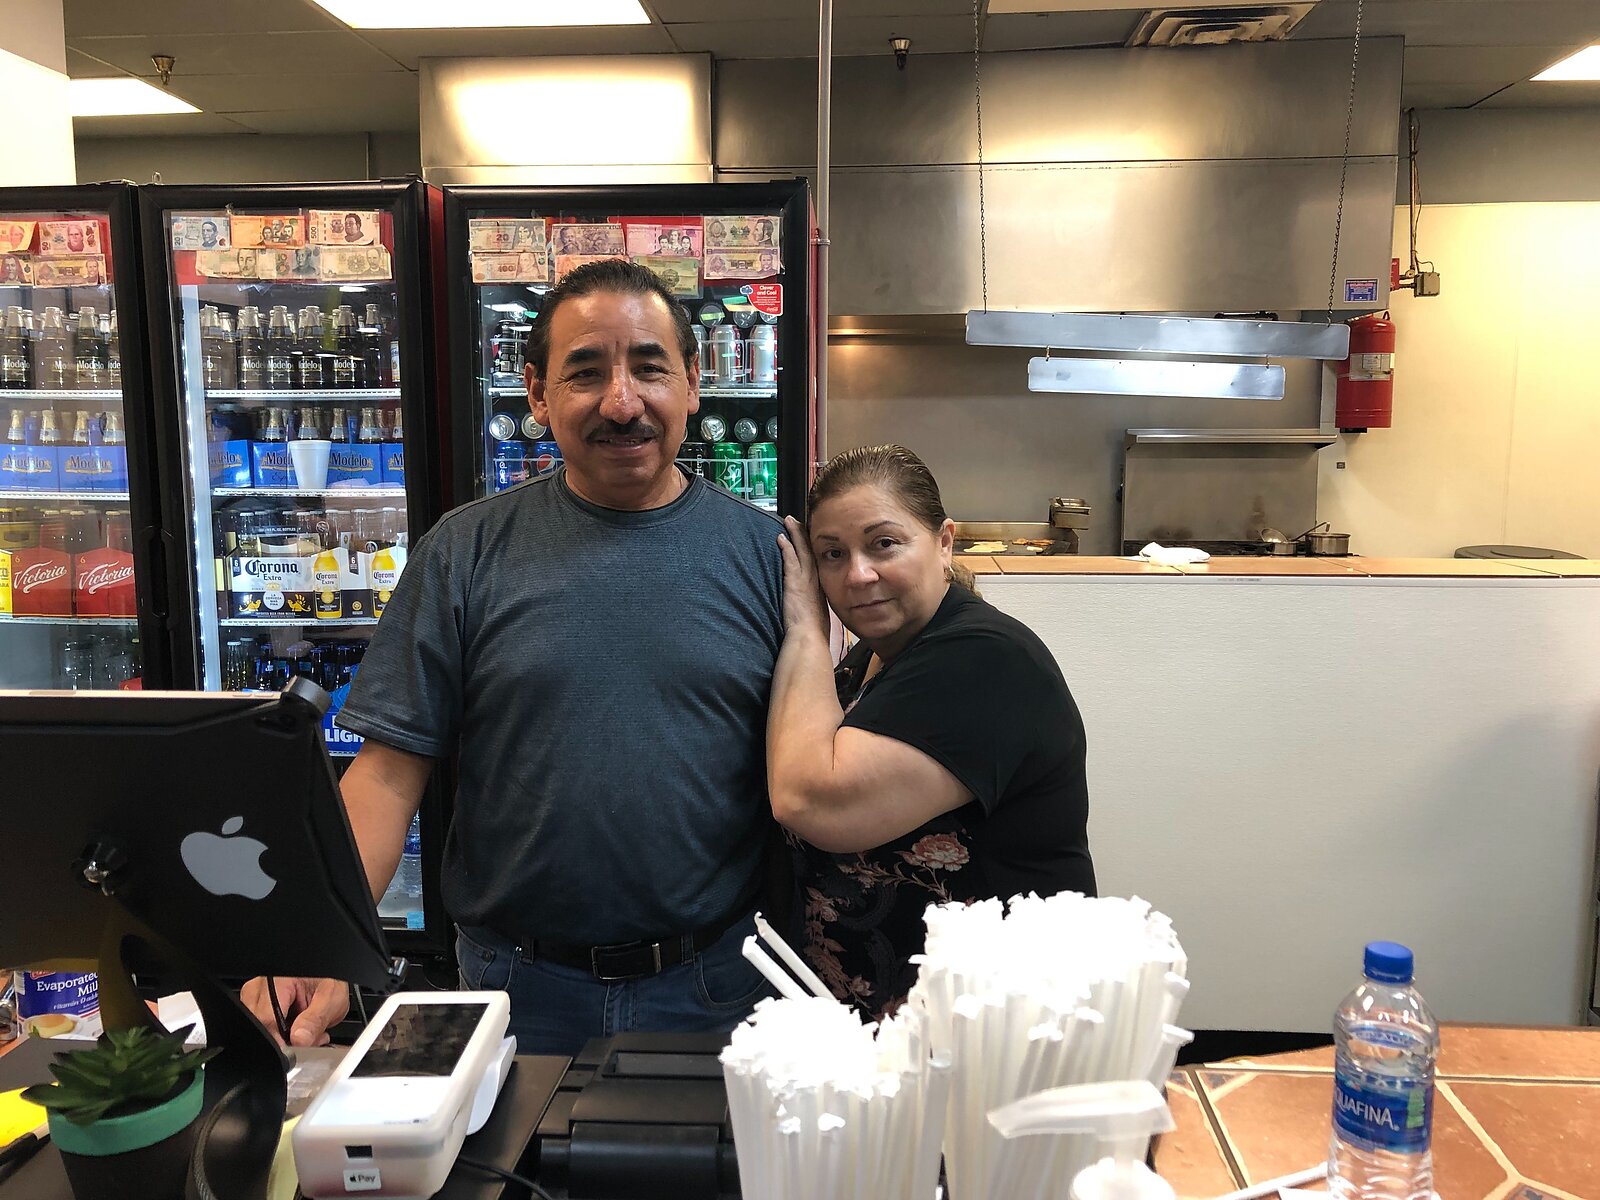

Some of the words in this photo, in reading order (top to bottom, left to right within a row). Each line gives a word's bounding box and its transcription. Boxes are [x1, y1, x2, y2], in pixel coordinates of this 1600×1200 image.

[174, 236, 181, 246] 20
[496, 233, 510, 241] 20
[78, 360, 104, 370] Modelo
[267, 358, 292, 369] Modelo
[333, 358, 357, 368] Modelo
[331, 452, 368, 467] Modelo
[234, 559, 239, 567] 6
[244, 559, 300, 578] Corona
[14, 560, 67, 594] Victoria
[79, 561, 134, 594] Victoria
[316, 572, 338, 580] Corona
[373, 571, 395, 580] Corona
[324, 728, 364, 743] LIGH
[357, 1174, 376, 1184] Pay
